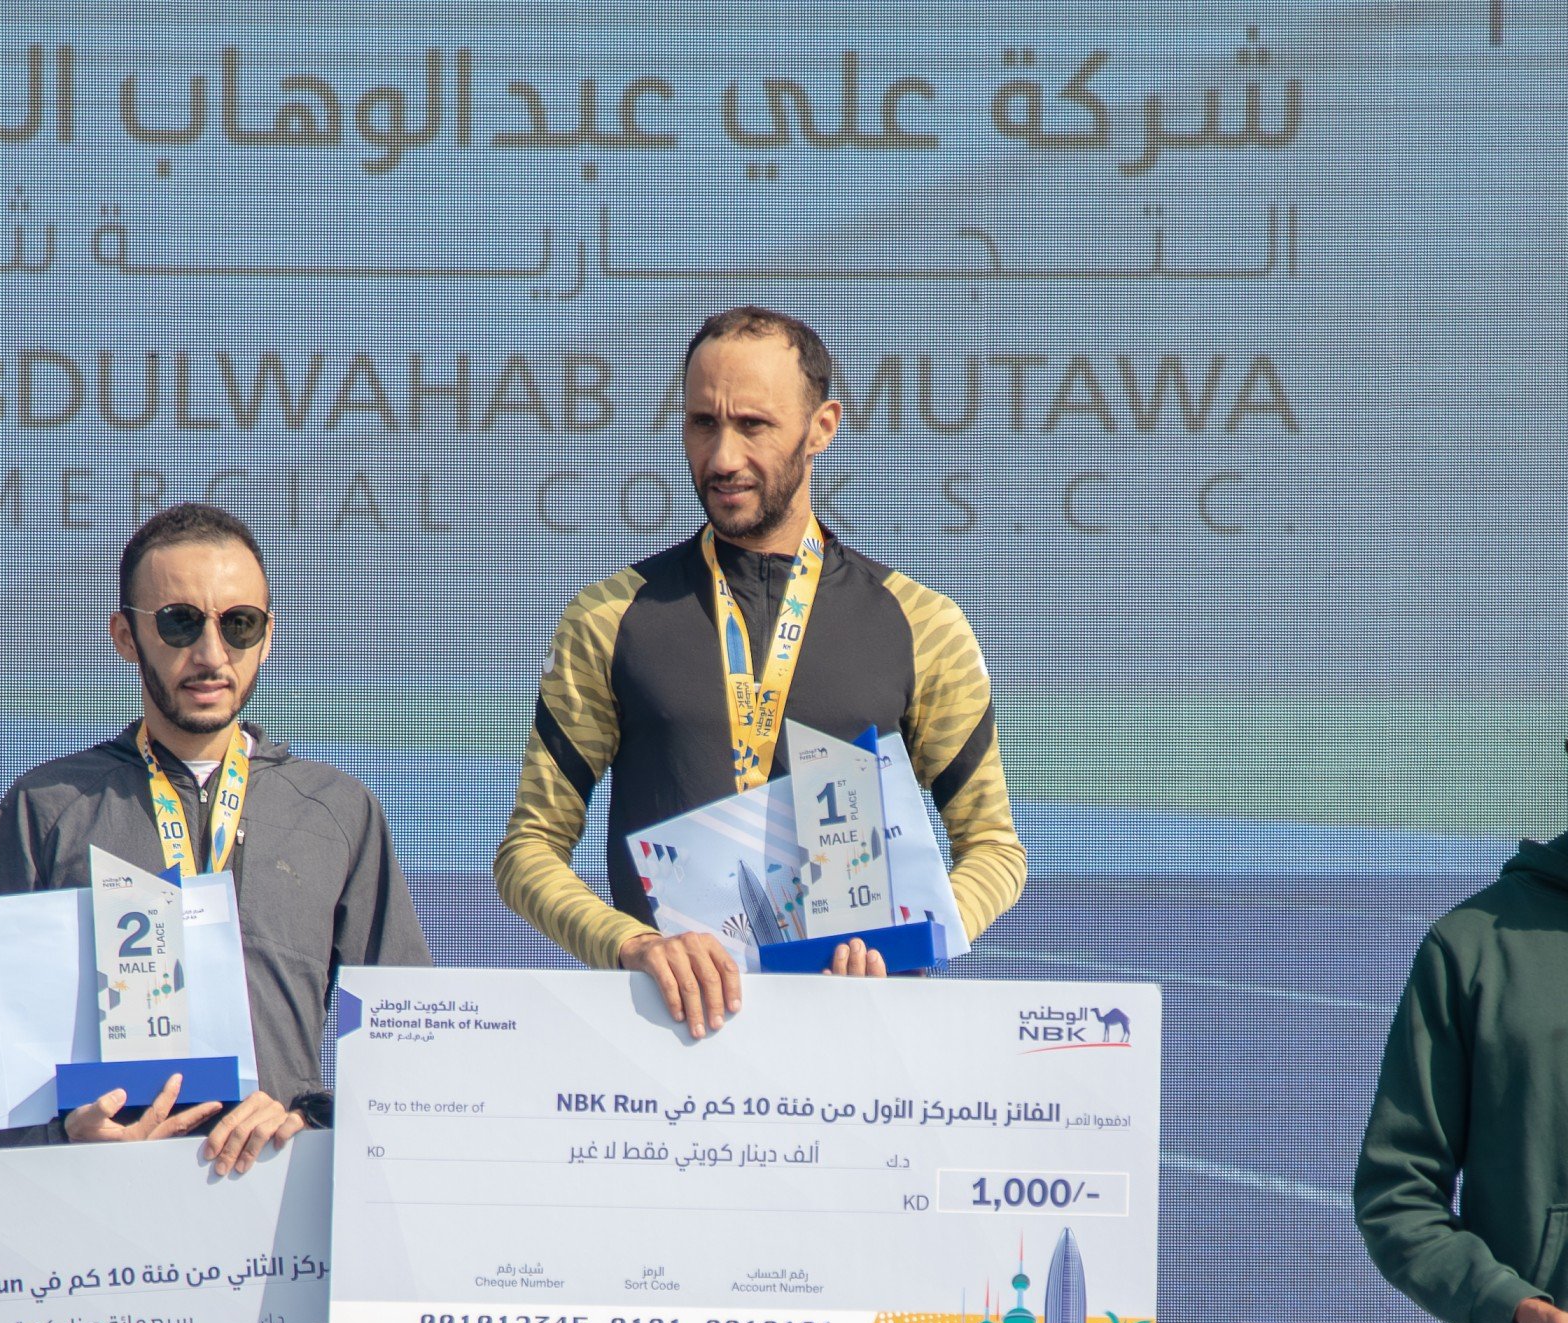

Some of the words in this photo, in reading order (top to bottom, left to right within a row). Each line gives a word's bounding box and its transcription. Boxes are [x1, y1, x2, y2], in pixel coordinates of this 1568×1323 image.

[990, 26, 1302, 178] شركة
[722, 50, 940, 179] علي
[778, 623, 802, 642] 10
[220, 789, 239, 811] 10
[848, 789, 859, 821] PLACE
[160, 821, 184, 840] 10
[819, 829, 859, 848] MALE
[811, 899, 829, 908] NBK
[811, 905, 830, 914] RUN
[156, 921, 166, 955] PLACE
[119, 962, 157, 975] MALE
[370, 1017, 422, 1030] National
[425, 1018, 455, 1030] Bank
[475, 1019, 517, 1031] Kuwait
[1019, 1006, 1088, 1025] الوطني
[108, 1025, 126, 1033] NBK
[108, 1032, 127, 1040] RUN
[1018, 1026, 1087, 1042] NBK
[368, 1100, 391, 1114] Pay
[410, 1101, 431, 1112] the
[434, 1102, 469, 1113] order
[556, 1093, 606, 1113] NBK
[614, 1095, 658, 1114] Run
[664, 1096, 696, 1126] في
[702, 1096, 735, 1120] كم
[743, 1097, 770, 1116] 10
[777, 1098, 815, 1116] فئة
[862, 1098, 913, 1124] الأول
[821, 1102, 856, 1124] من
[920, 1101, 997, 1126] بالمركز
[1004, 1101, 1061, 1127] الفائز
[367, 1147, 385, 1158] KD
[568, 1141, 598, 1164] غير
[622, 1141, 669, 1160] فقط
[675, 1143, 732, 1172] كويتي
[738, 1143, 777, 1167] دينار
[783, 1140, 820, 1163] ألف
[903, 1195, 929, 1211] KD
[972, 1177, 1100, 1211] 1,000/-
[68, 1269, 101, 1295] كم
[108, 1267, 135, 1286] 10
[141, 1263, 179, 1284] فئة
[186, 1265, 221, 1287] من
[227, 1254, 284, 1291] الثاني
[30, 1273, 61, 1303] في
[475, 1277, 517, 1290] Cheque
[520, 1277, 565, 1289] Number
[625, 1280, 647, 1291] Sort
[650, 1280, 681, 1291] Code
[731, 1282, 777, 1294] Account
[780, 1282, 824, 1294] Number
